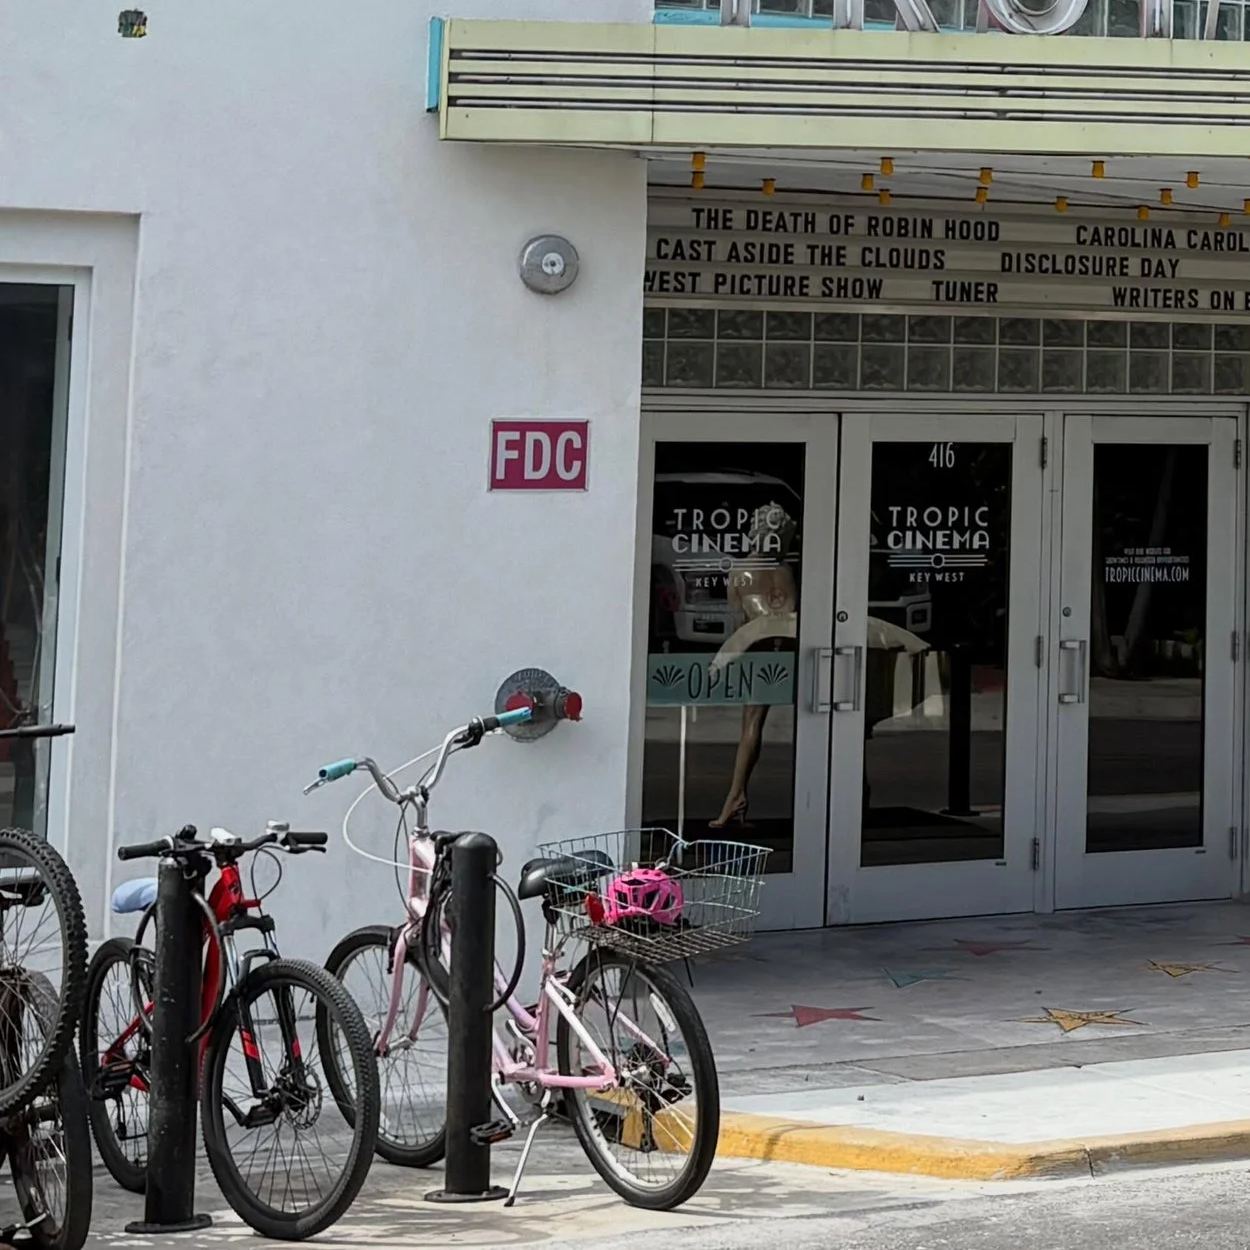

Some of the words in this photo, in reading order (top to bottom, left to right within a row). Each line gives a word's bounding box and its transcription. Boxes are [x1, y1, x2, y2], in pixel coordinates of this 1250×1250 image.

[691, 208, 734, 230] THE
[746, 209, 817, 234] DEATH
[829, 214, 855, 236] OF
[867, 216, 933, 239] ROBIN
[944, 219, 1000, 242] HOOD
[1076, 225, 1177, 249] CAROLINA
[656, 238, 717, 262] CAST
[726, 241, 795, 265] ASIDE
[806, 244, 847, 267] THE
[861, 247, 946, 270] CLOUDS
[1001, 252, 1129, 277] DISCLOSURE
[1140, 258, 1180, 279] DAY
[714, 273, 810, 297] PICTURE
[821, 277, 883, 299] SHOW
[932, 280, 999, 302] TUNER
[1112, 286, 1199, 309] WRITERS
[1210, 290, 1235, 311] ON
[495, 431, 582, 481] FDC
[928, 442, 955, 468] 416
[673, 508, 781, 530] TROPIC
[888, 506, 989, 527] TROPIC
[672, 533, 781, 553] CINEMA
[887, 530, 990, 549] CINEMA
[695, 577, 718, 587] KEY
[910, 572, 931, 583] KEY
[935, 572, 965, 583] WEST
[1105, 566, 1189, 582] TROPICCINEMA.COM
[688, 662, 753, 699] OPEN
